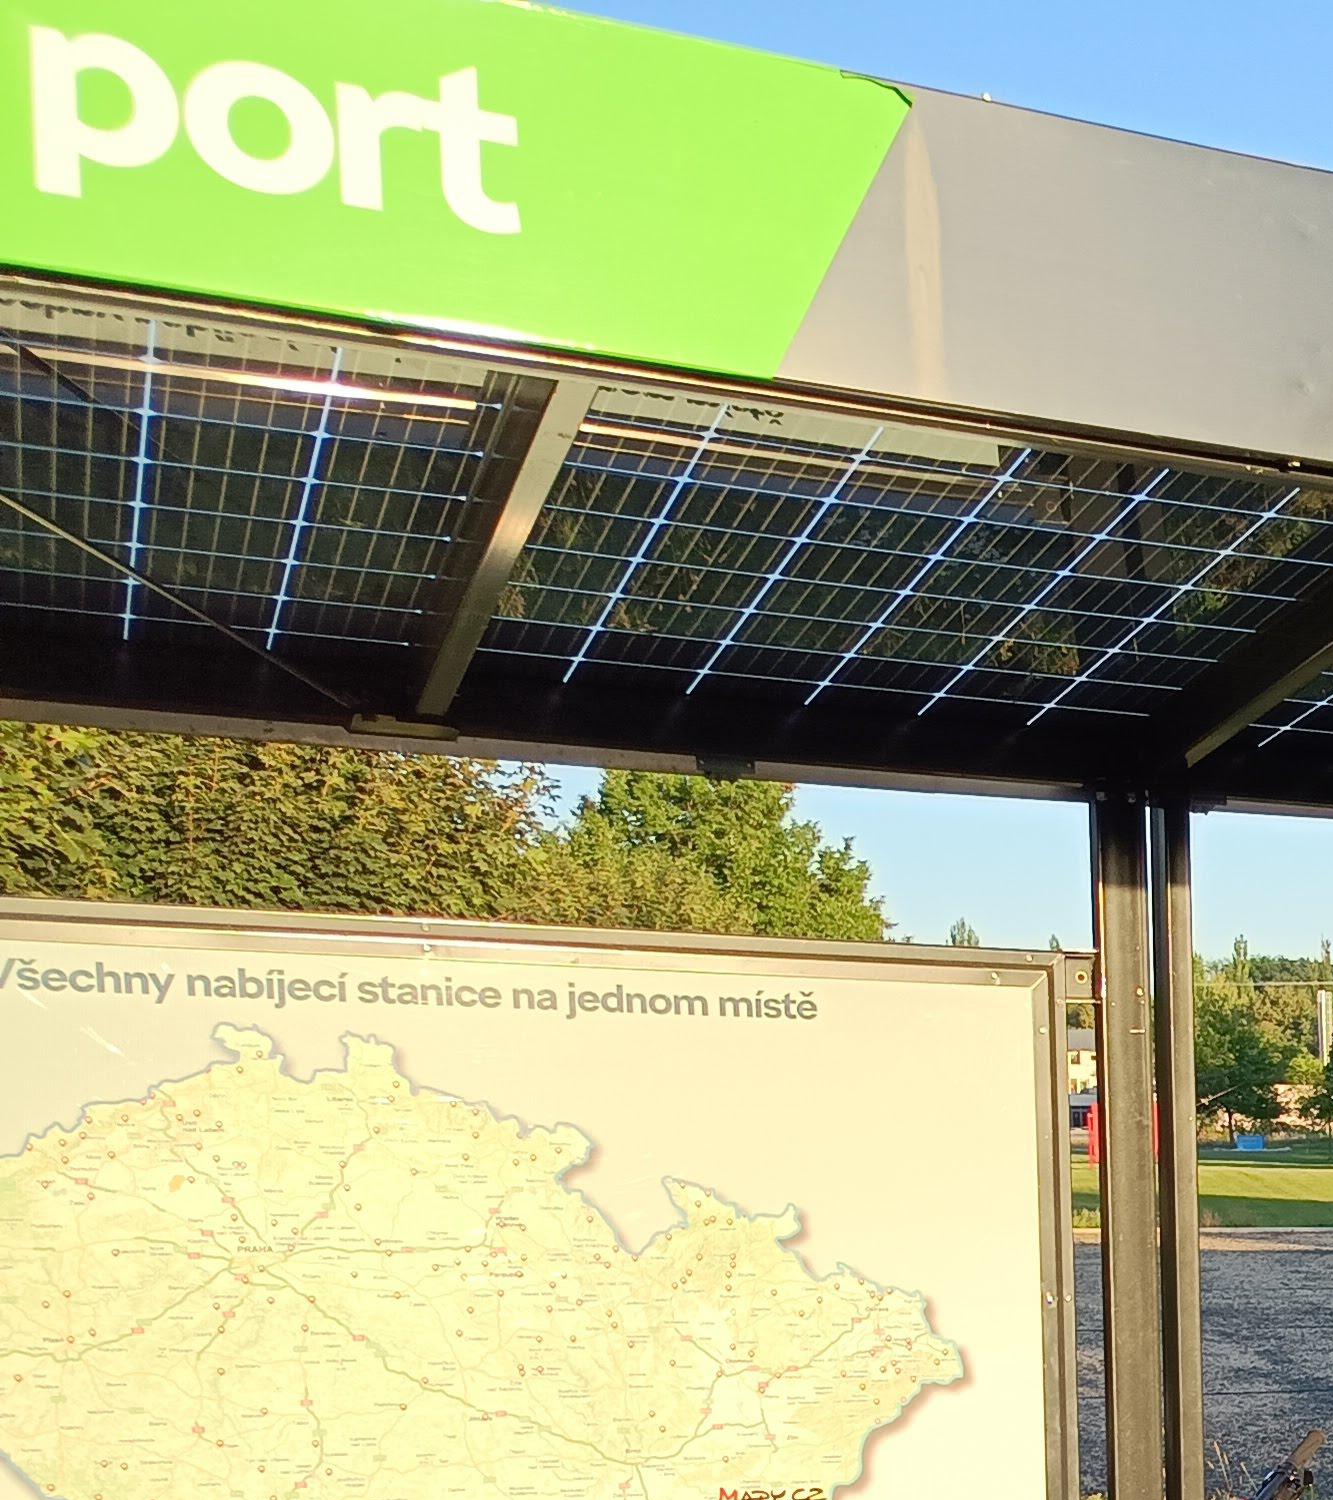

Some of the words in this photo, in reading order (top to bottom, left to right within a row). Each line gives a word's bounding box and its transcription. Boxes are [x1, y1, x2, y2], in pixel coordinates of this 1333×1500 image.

[28, 24, 522, 234] port
[187, 968, 348, 1008] nabíjecí
[357, 976, 502, 1008] stanice
[512, 986, 558, 1011] na
[566, 982, 709, 1020] jednom
[719, 990, 819, 1020] místě
